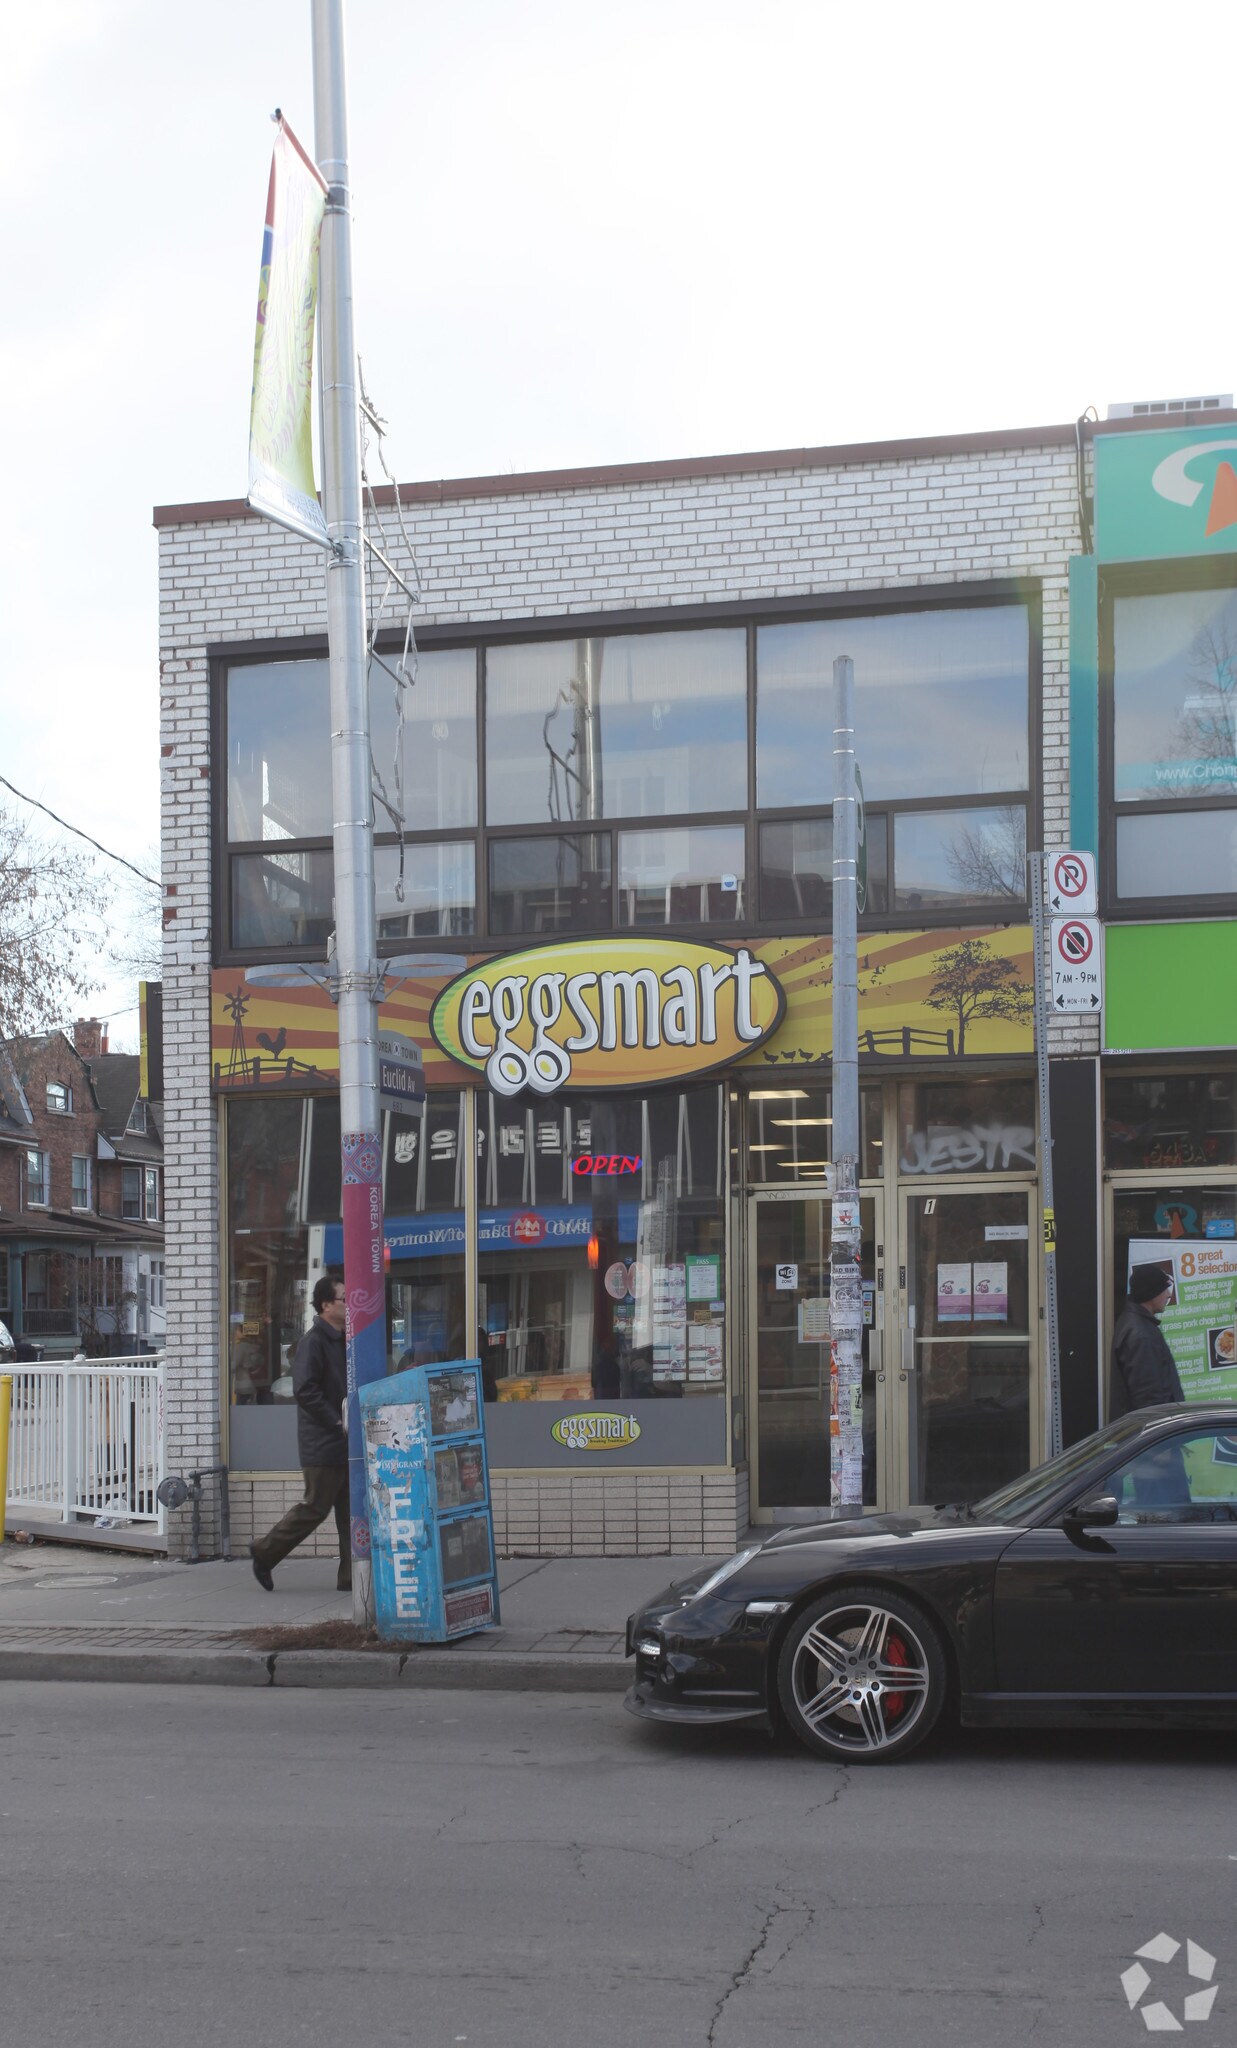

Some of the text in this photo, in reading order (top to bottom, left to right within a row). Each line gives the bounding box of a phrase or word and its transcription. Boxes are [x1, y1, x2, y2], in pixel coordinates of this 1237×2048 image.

[459, 948, 767, 1097] eggsmart
[378, 1040, 418, 1061] OREA TOWN
[382, 1065, 416, 1093] Euclid Av
[573, 1155, 640, 1176] OPEN
[369, 1186, 380, 1273] KOREA TOWN
[1181, 1249, 1223, 1278] 8 great
[1183, 1280, 1234, 1293] vegetable soup
[1184, 1286, 1232, 1300] and spring roll
[1162, 1322, 1182, 1332] grass
[1183, 1318, 1199, 1330] pork
[1199, 1316, 1216, 1327] chop
[1178, 1365, 1204, 1376] ermicelli
[1181, 1380, 1196, 1389] ouse
[560, 1414, 637, 1449] eggsmart
[389, 1486, 421, 1618] FREE
